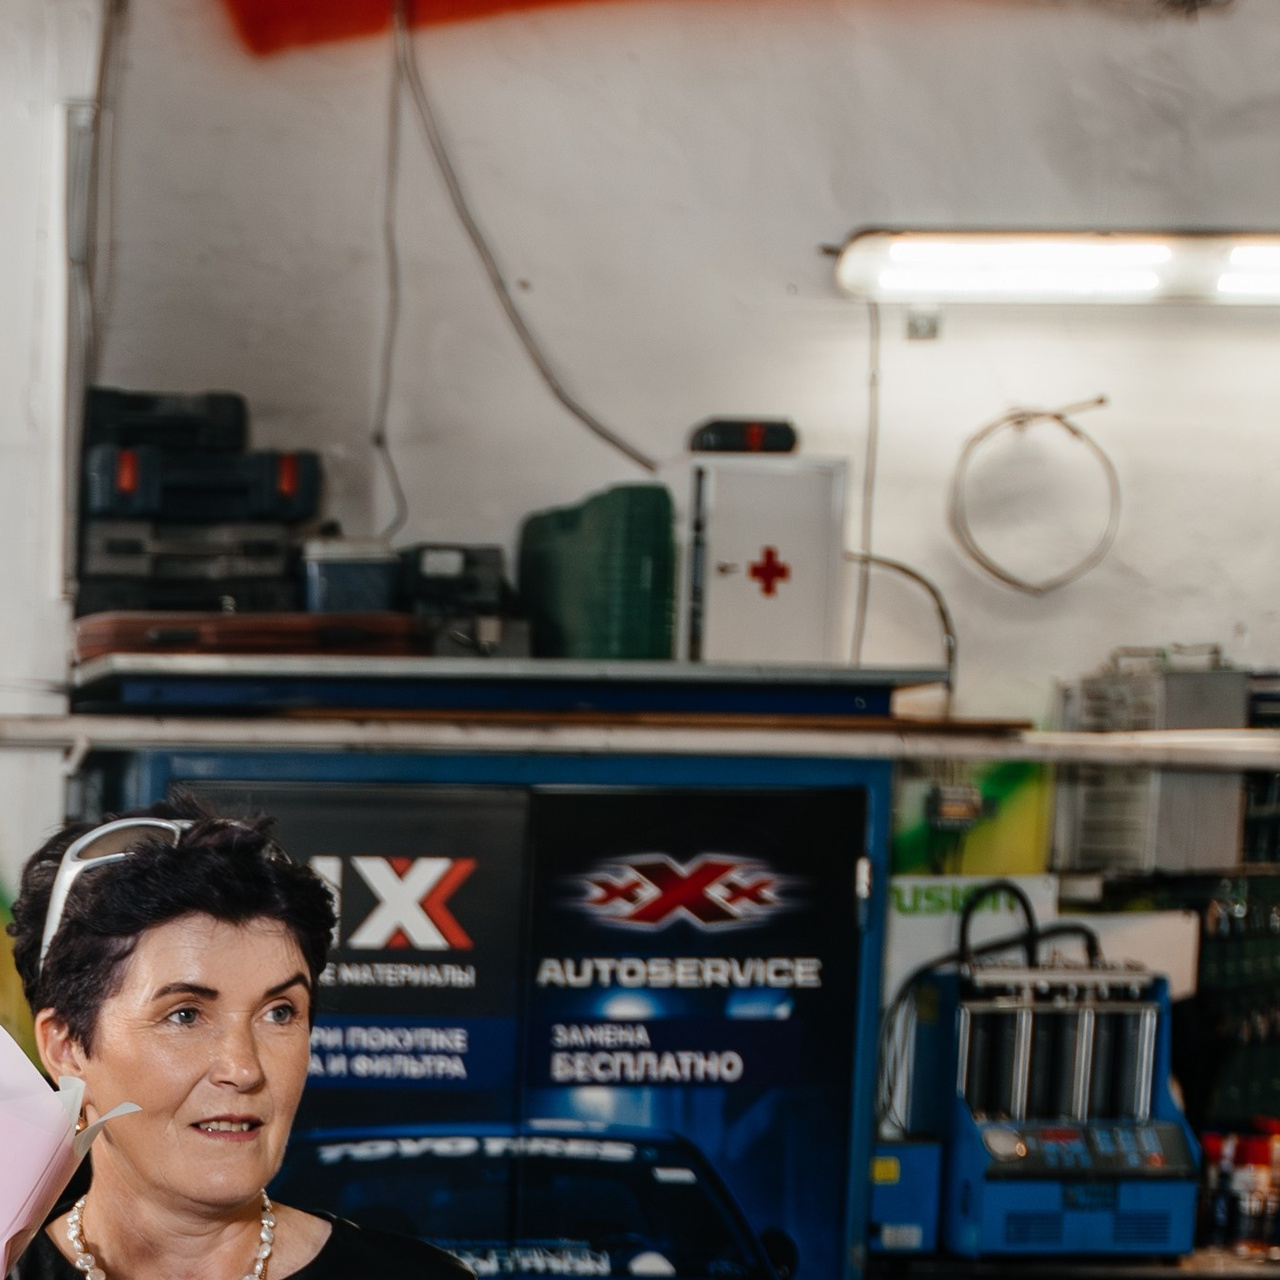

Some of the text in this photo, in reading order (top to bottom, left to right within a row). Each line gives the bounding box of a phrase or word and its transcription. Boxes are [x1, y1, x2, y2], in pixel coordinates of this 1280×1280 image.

[338, 963, 476, 987] МАТЕРИАЛЫ
[537, 957, 822, 988] AUTOSERVICE
[346, 1027, 469, 1053] ПОКУПКЕ
[552, 1024, 651, 1048] ЗАМЕНА
[326, 1055, 348, 1077] И
[349, 1056, 468, 1079] ФИЛЬТРА
[551, 1051, 743, 1082] БЕСПЛАТНО
[319, 1136, 479, 1164] TOYO
